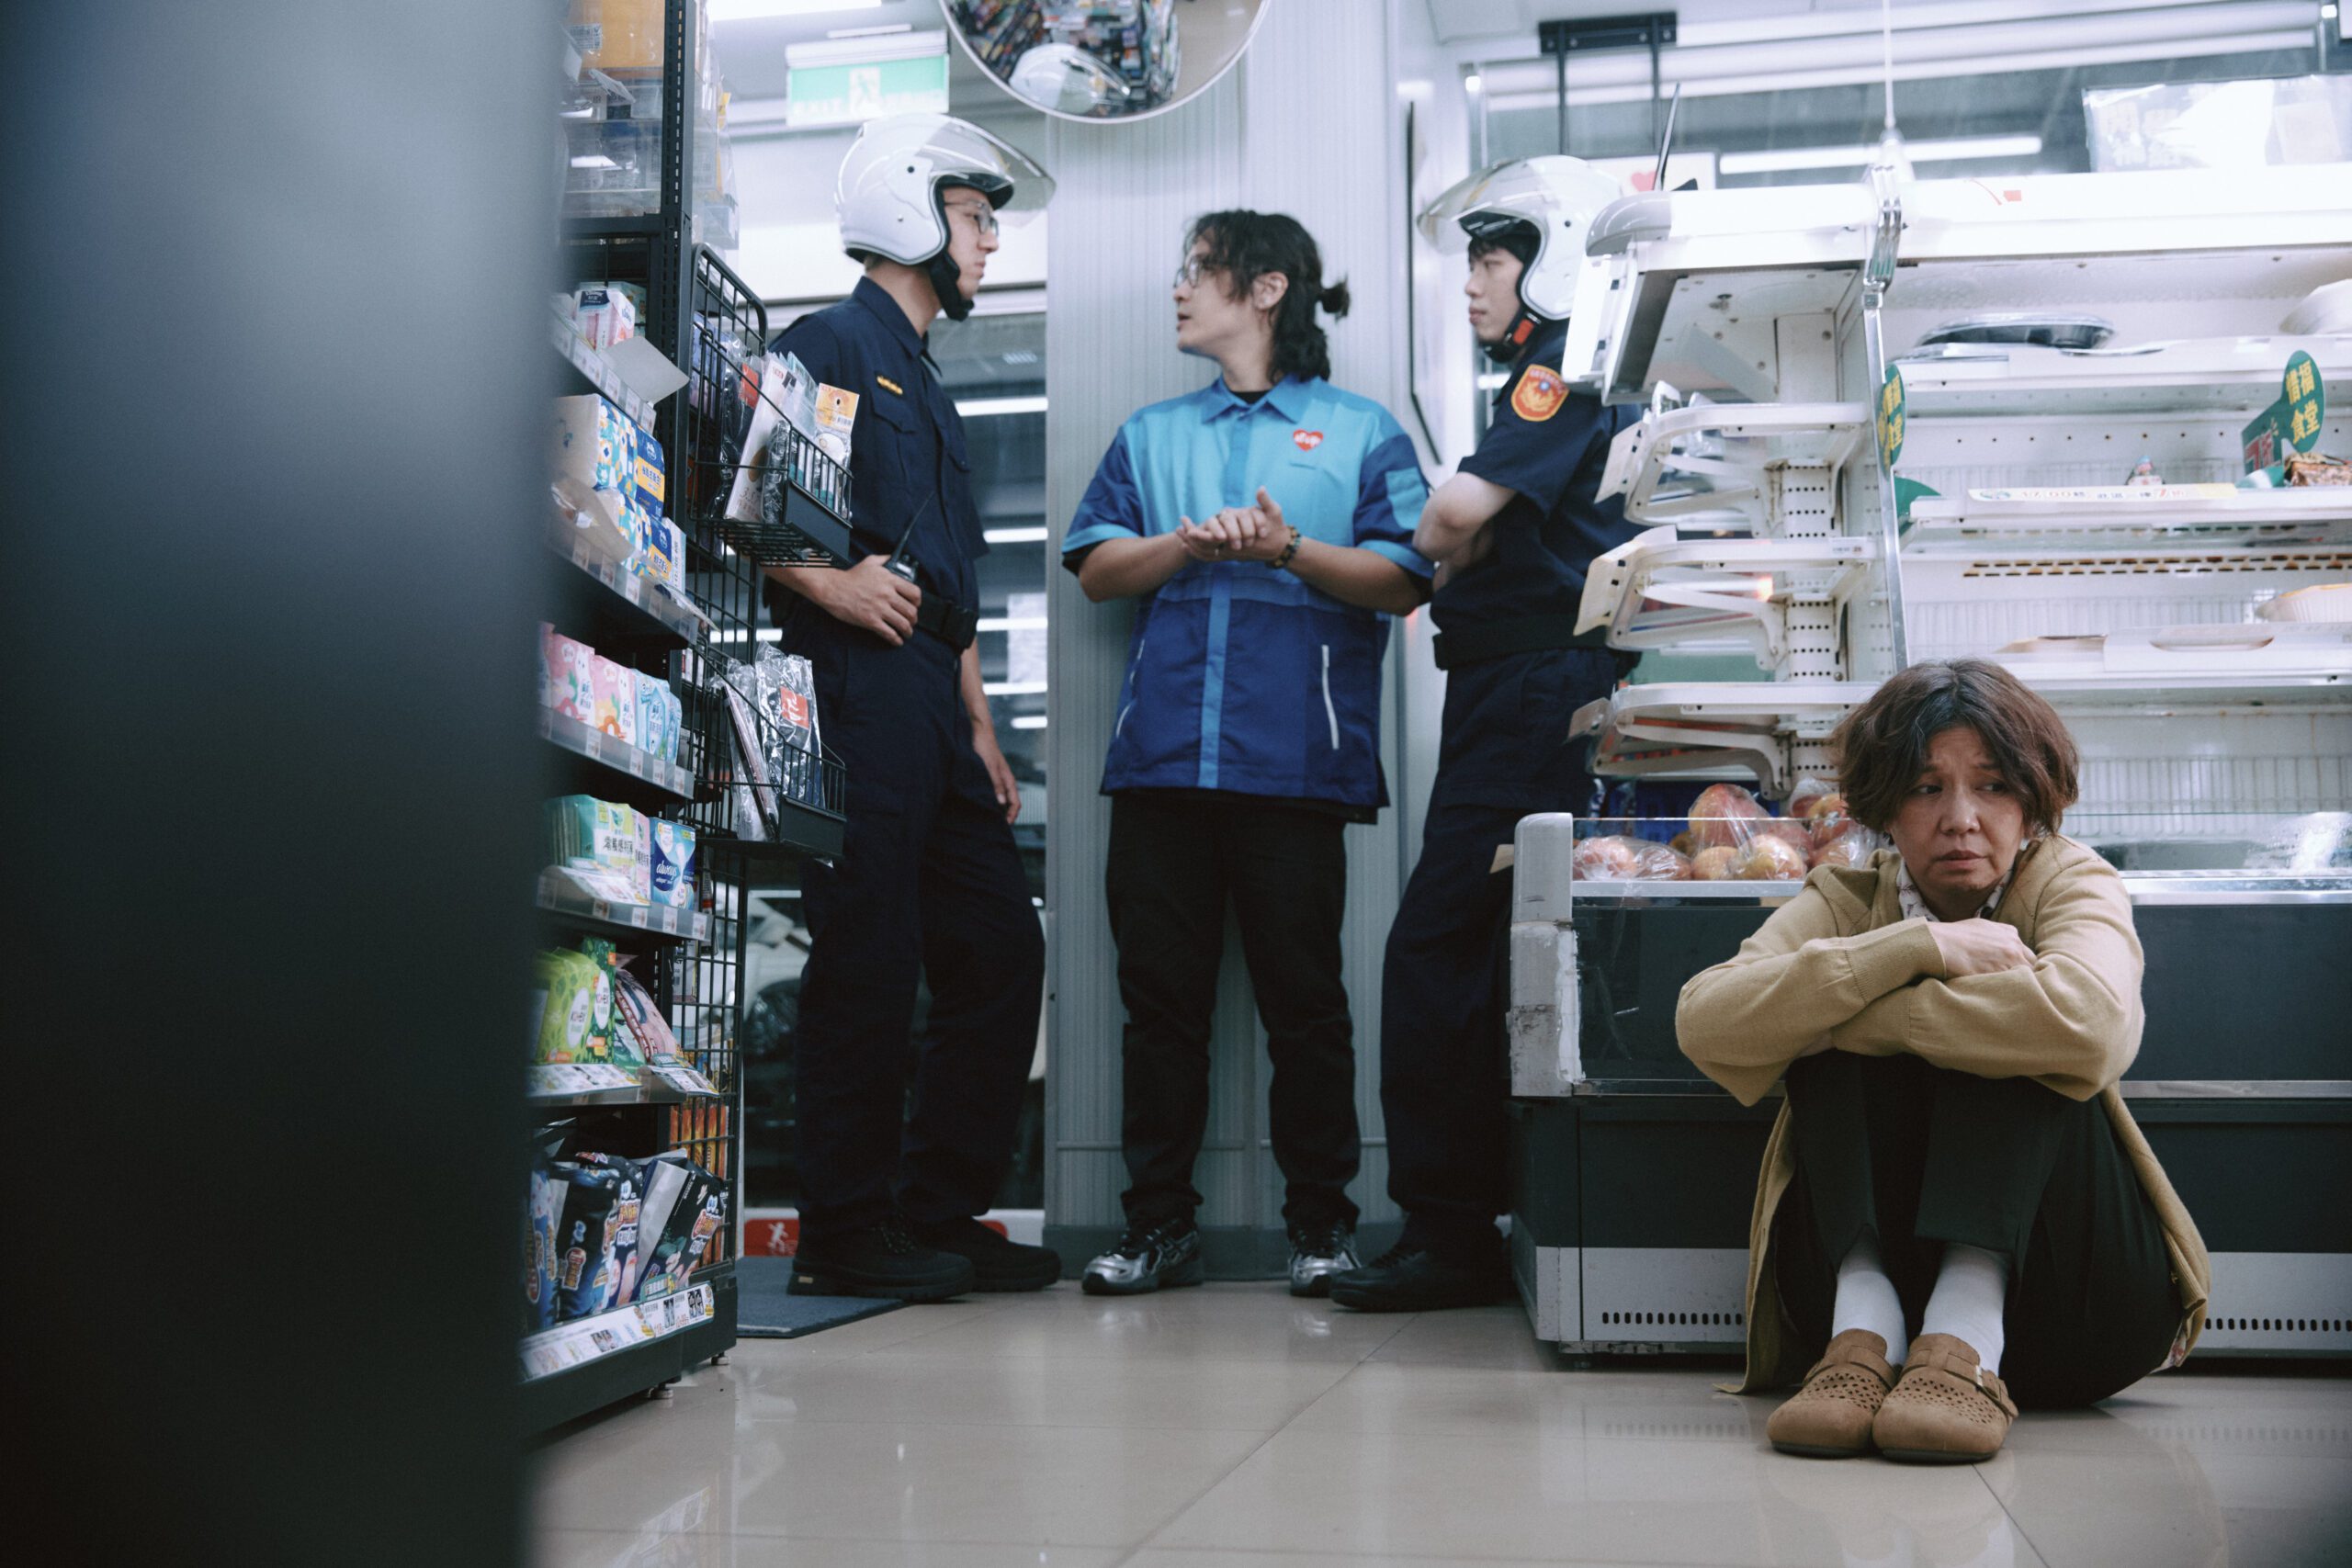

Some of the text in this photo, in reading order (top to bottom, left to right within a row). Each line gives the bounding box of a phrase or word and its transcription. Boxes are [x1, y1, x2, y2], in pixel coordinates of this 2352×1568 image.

[2285, 359, 2315, 405] 惜福
[2290, 399, 2321, 445] 食堂
[656, 860, 677, 881] always
